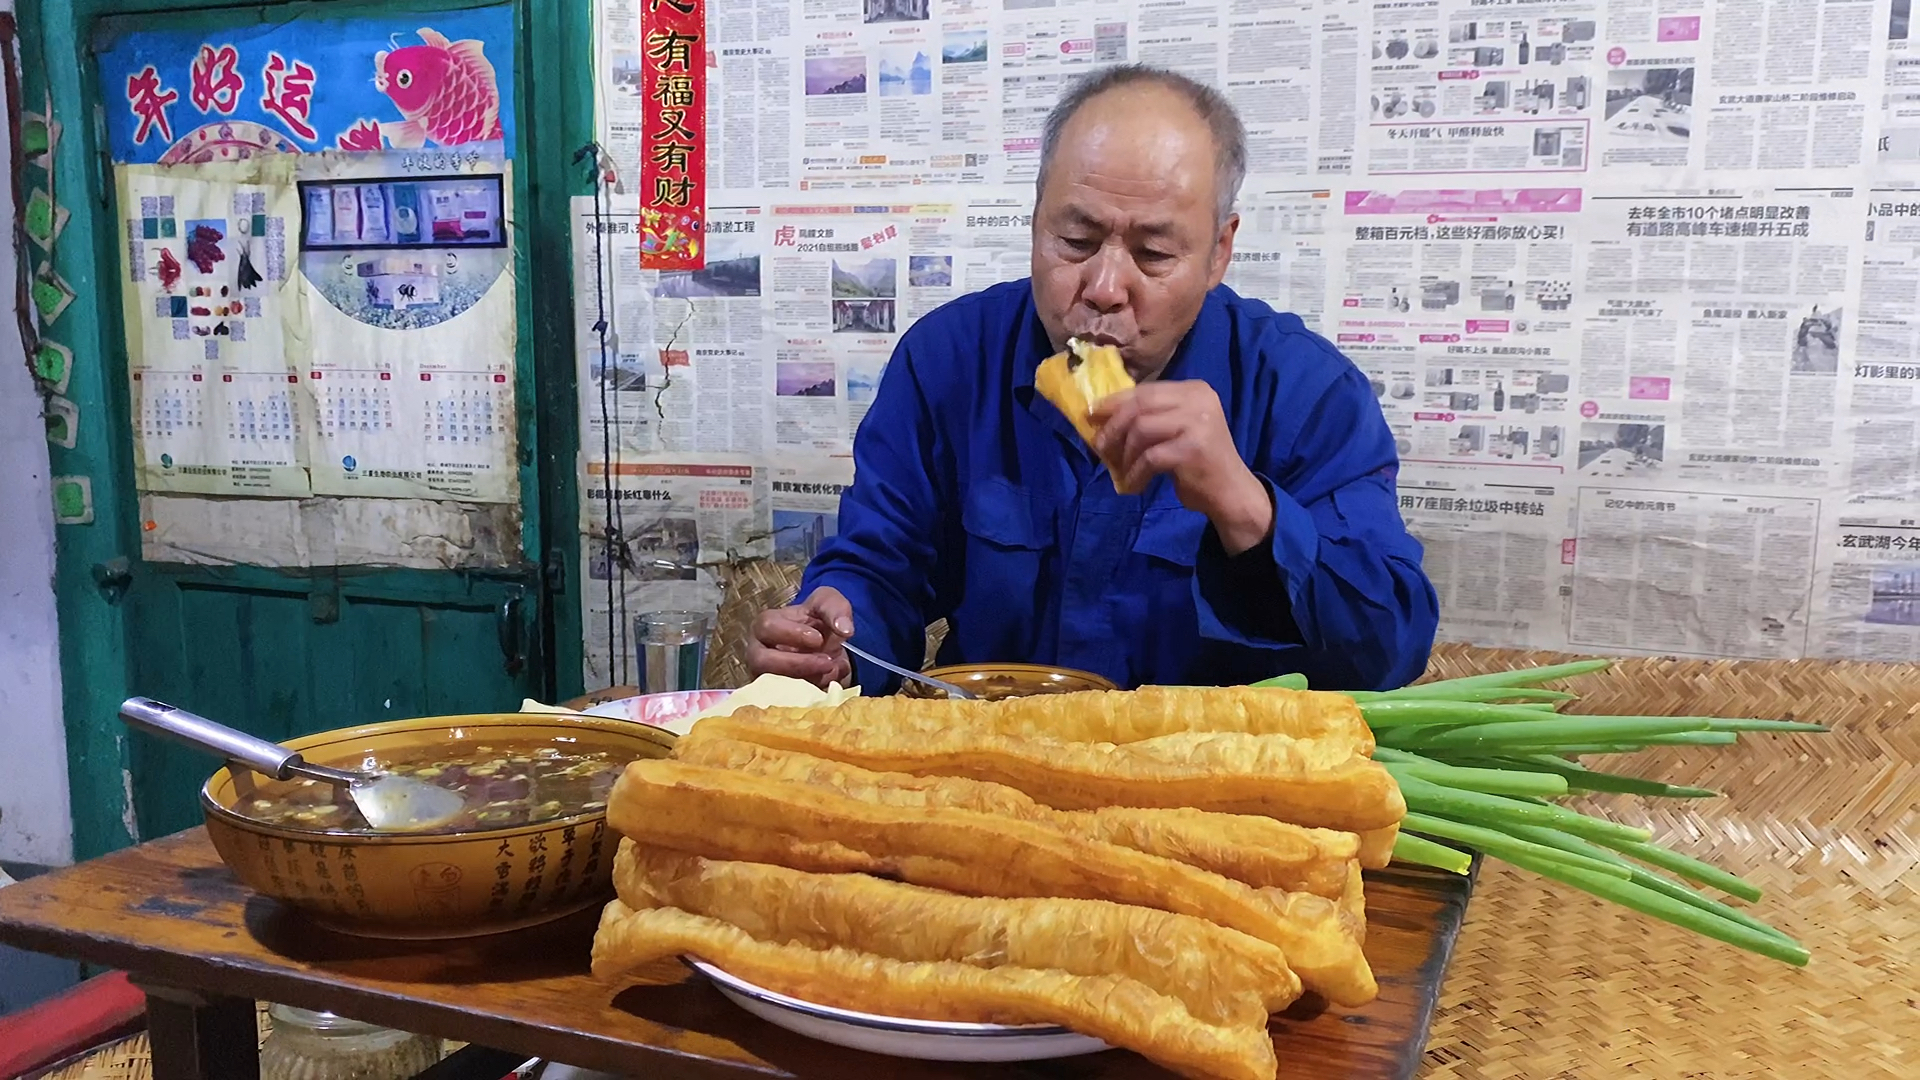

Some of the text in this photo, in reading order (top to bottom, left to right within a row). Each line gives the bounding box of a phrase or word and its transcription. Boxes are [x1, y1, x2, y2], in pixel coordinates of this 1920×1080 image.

[1387, 127, 1443, 139] 冬天开暖气
[1628, 206, 1811, 220] 去年全市10个堵点明显改善
[774, 225, 796, 247] 虎
[1627, 221, 1809, 237] 有道路高峰车速提升五成
[1400, 495, 1544, 517] 用7座厨余垃圾中转站
